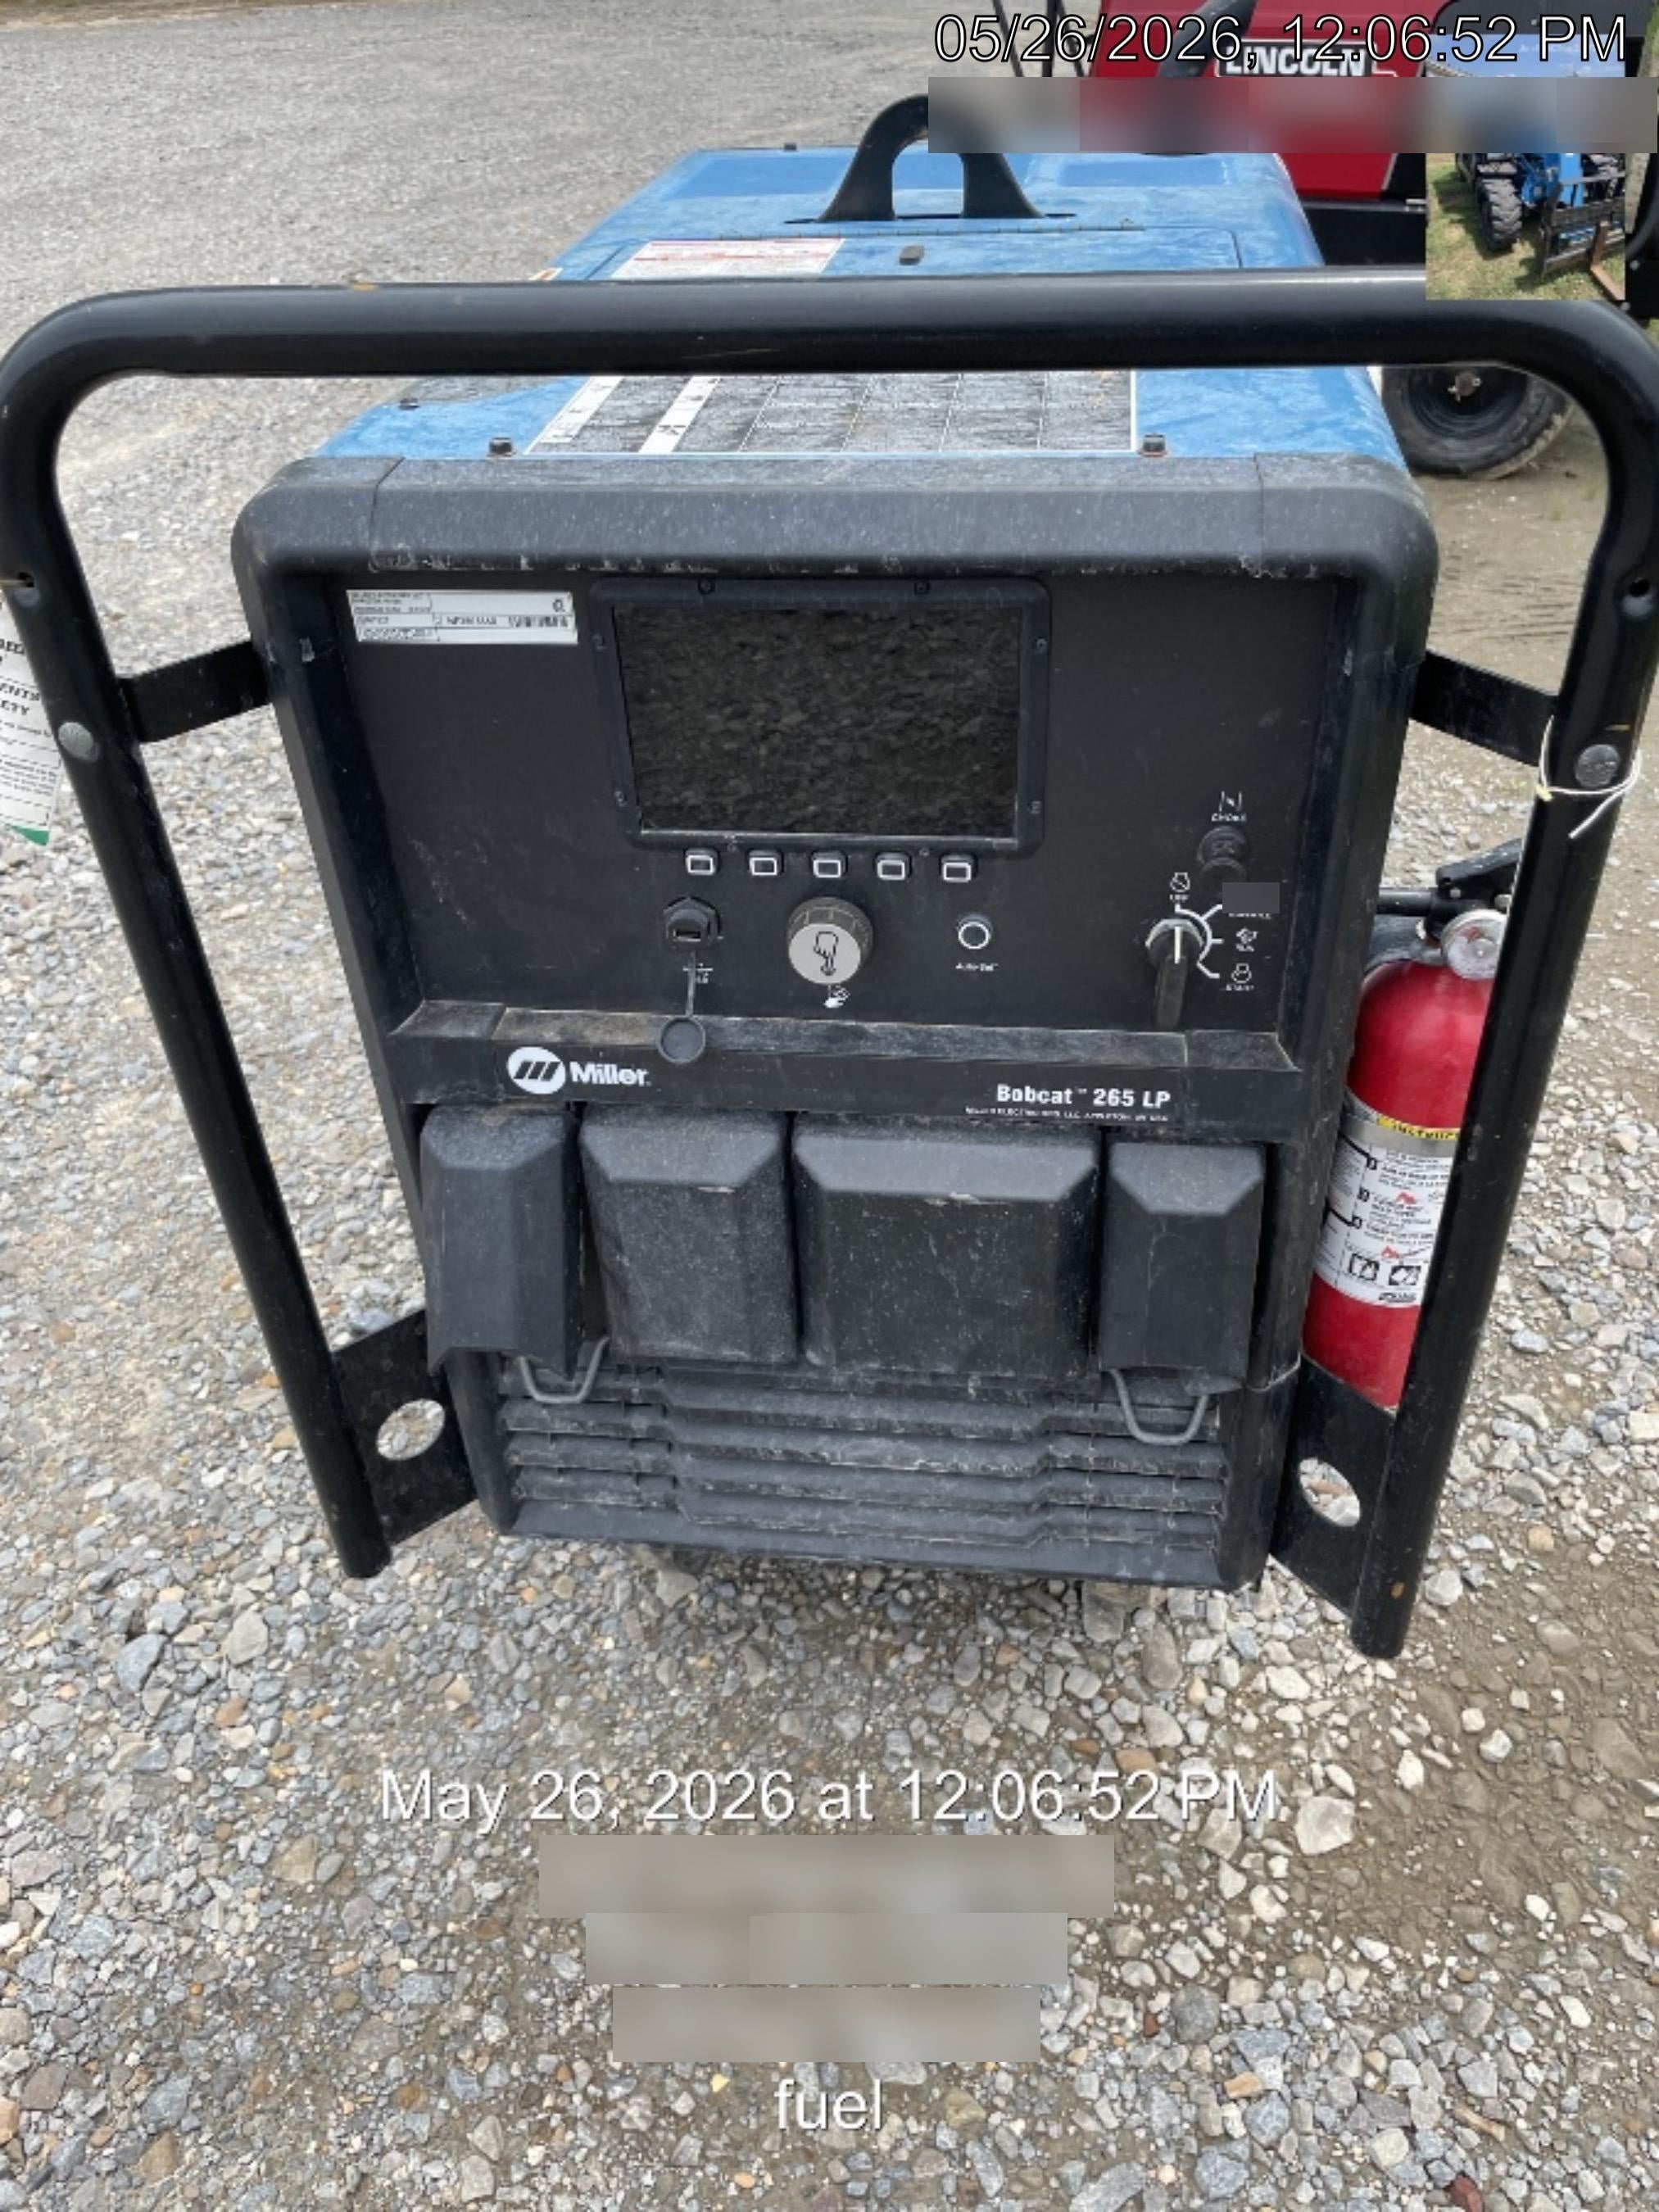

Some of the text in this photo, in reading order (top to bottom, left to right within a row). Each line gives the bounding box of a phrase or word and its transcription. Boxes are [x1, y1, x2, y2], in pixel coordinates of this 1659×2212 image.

[1226, 45, 1366, 76] LINCOLN
[569, 1061, 650, 1087] Miller
[996, 1083, 1171, 1109] Bobcat 265 LP
